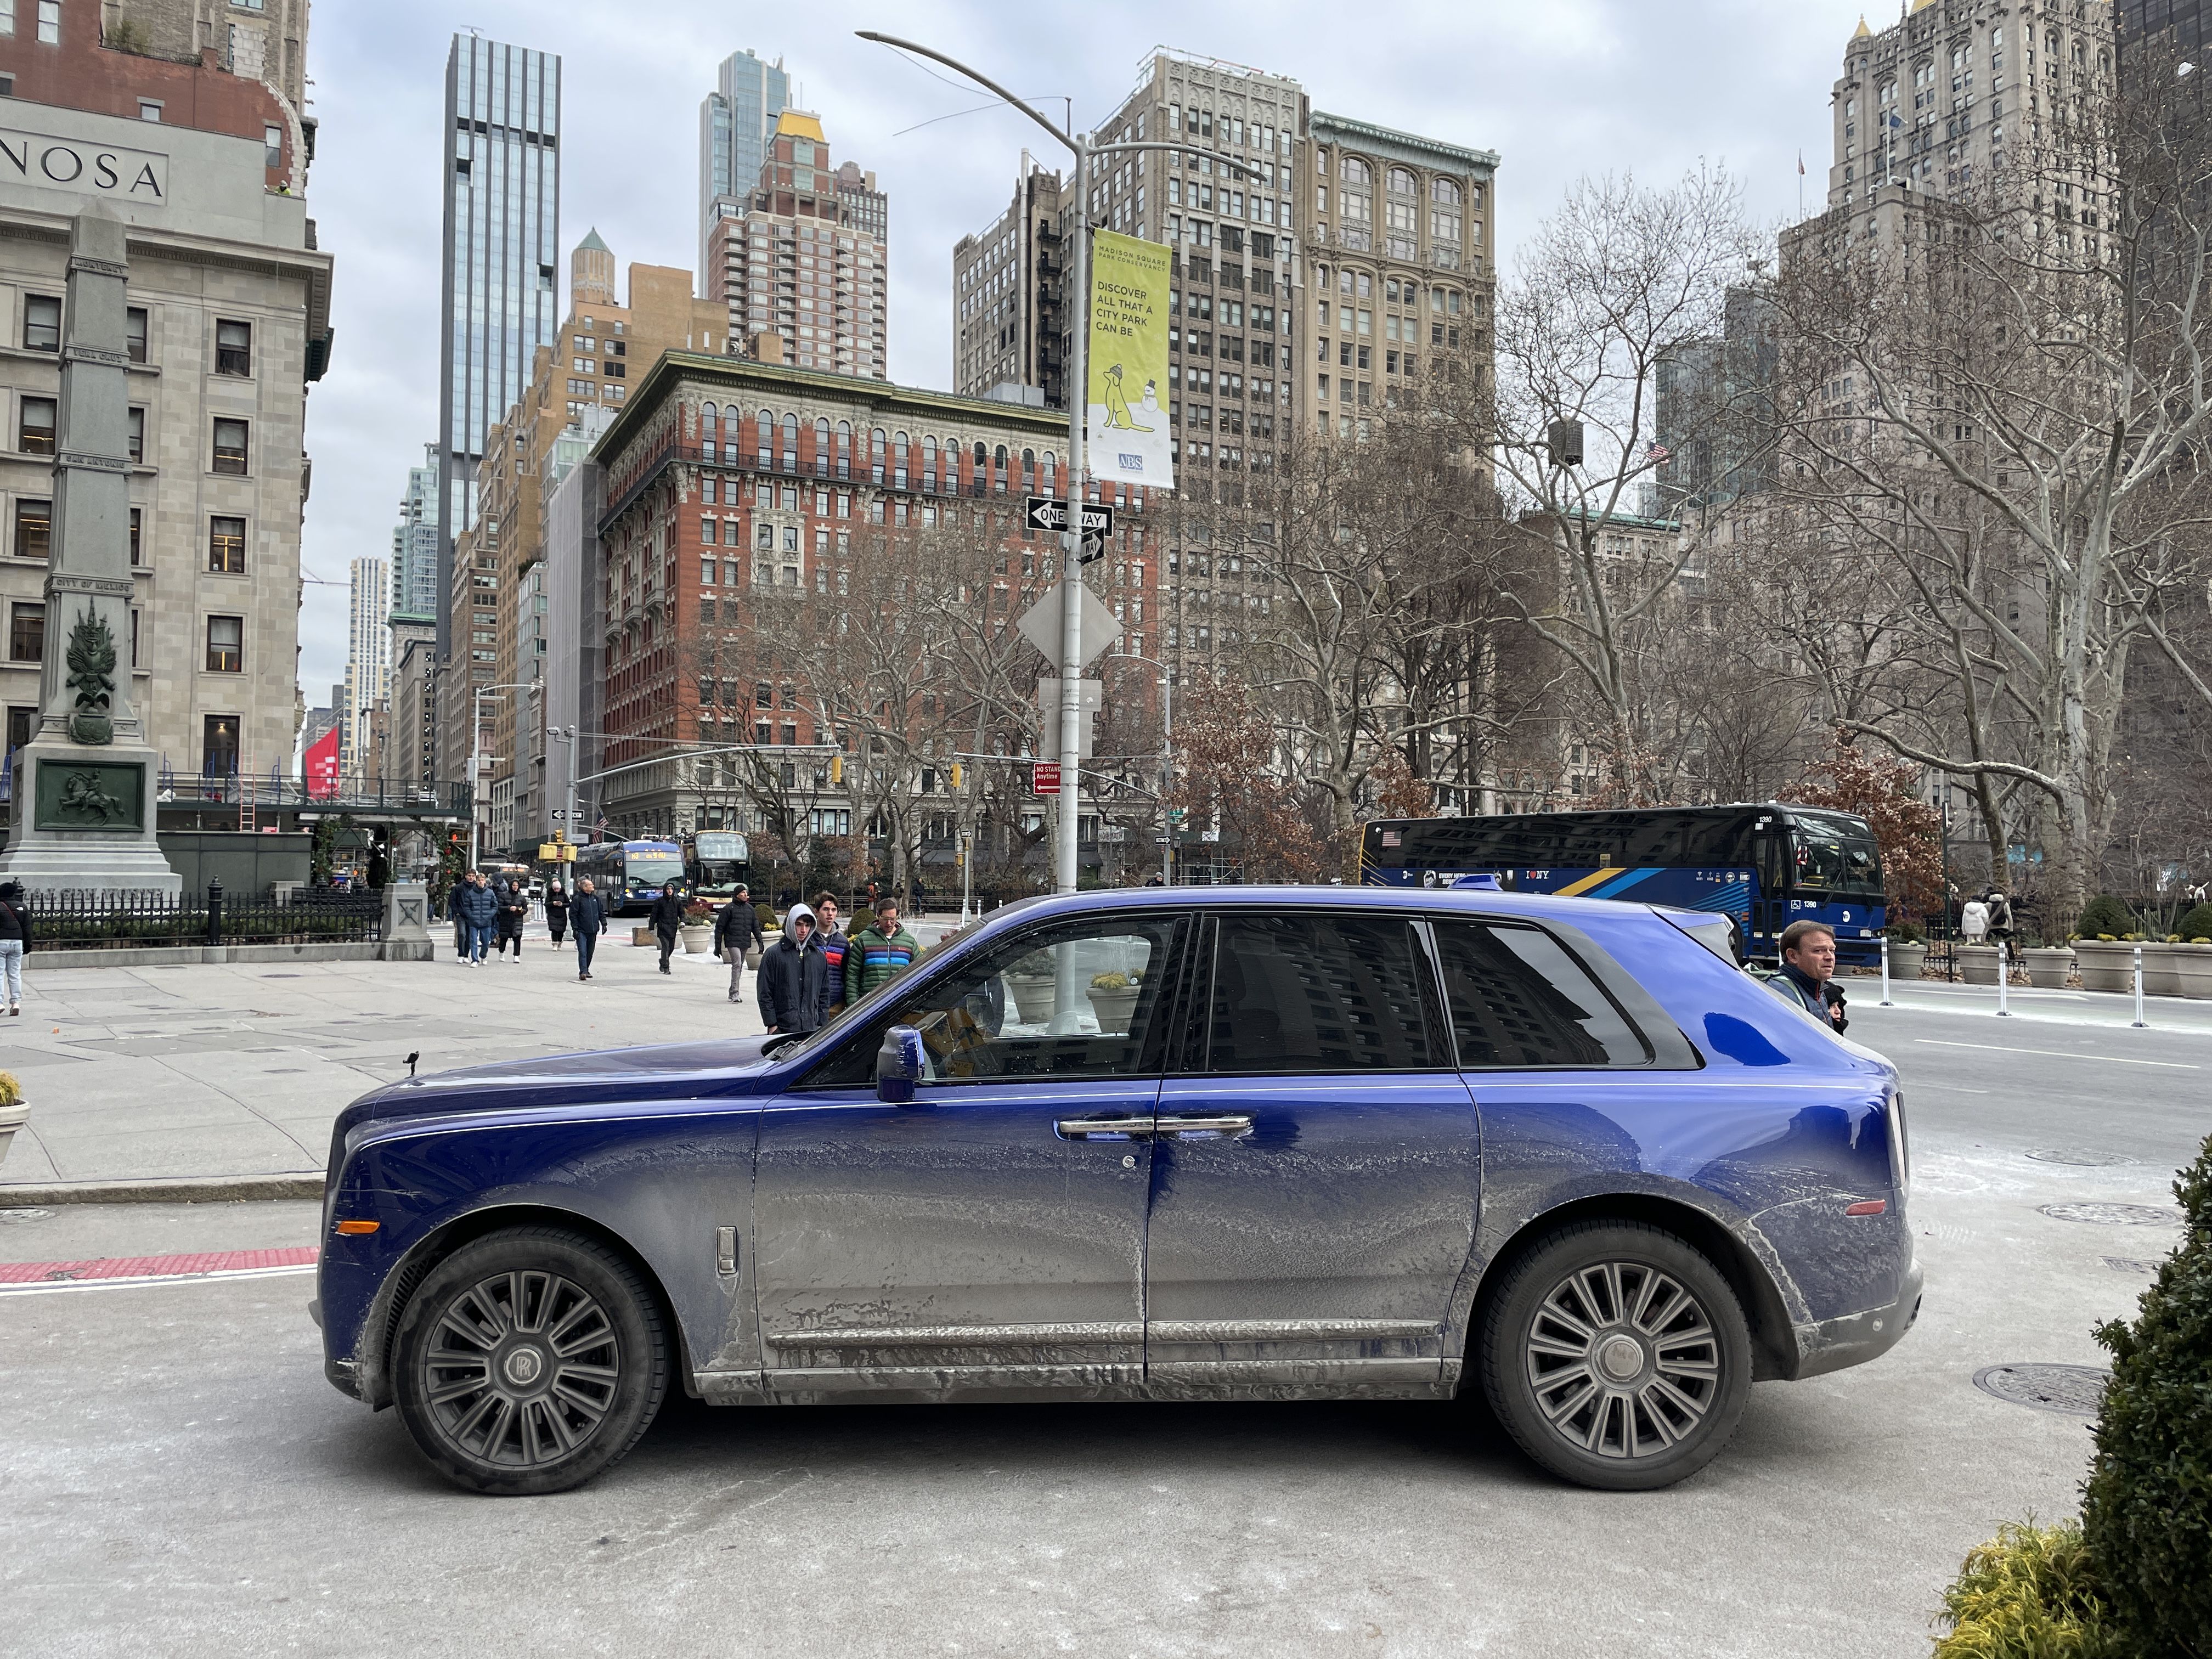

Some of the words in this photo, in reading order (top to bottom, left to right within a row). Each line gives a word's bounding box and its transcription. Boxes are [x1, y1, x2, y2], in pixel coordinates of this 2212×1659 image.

[1099, 245, 1133, 258] MADISON
[1137, 255, 1166, 266] SQUARE
[1099, 252, 1115, 260] PARK
[1118, 257, 1165, 272] CONSERVANCY
[1098, 281, 1147, 300] DISCOVER
[1097, 295, 1115, 306] ALL
[1119, 299, 1143, 312] THAT
[1146, 306, 1153, 314] A
[1097, 308, 1119, 320] CITY
[1122, 313, 1147, 326] PARK
[1096, 321, 1117, 334] CAN
[1120, 326, 1133, 336] BE
[66, 455, 84, 464] SAN
[1119, 455, 1142, 469] ABS
[1041, 509, 1065, 522] ONE
[1086, 539, 1098, 554] WAY
[57, 578, 77, 587] CITY
[95, 582, 130, 591] MEXICO
[1526, 870, 1530, 879] I
[1536, 870, 1549, 879] NY
[1803, 900, 1817, 909] 1390
